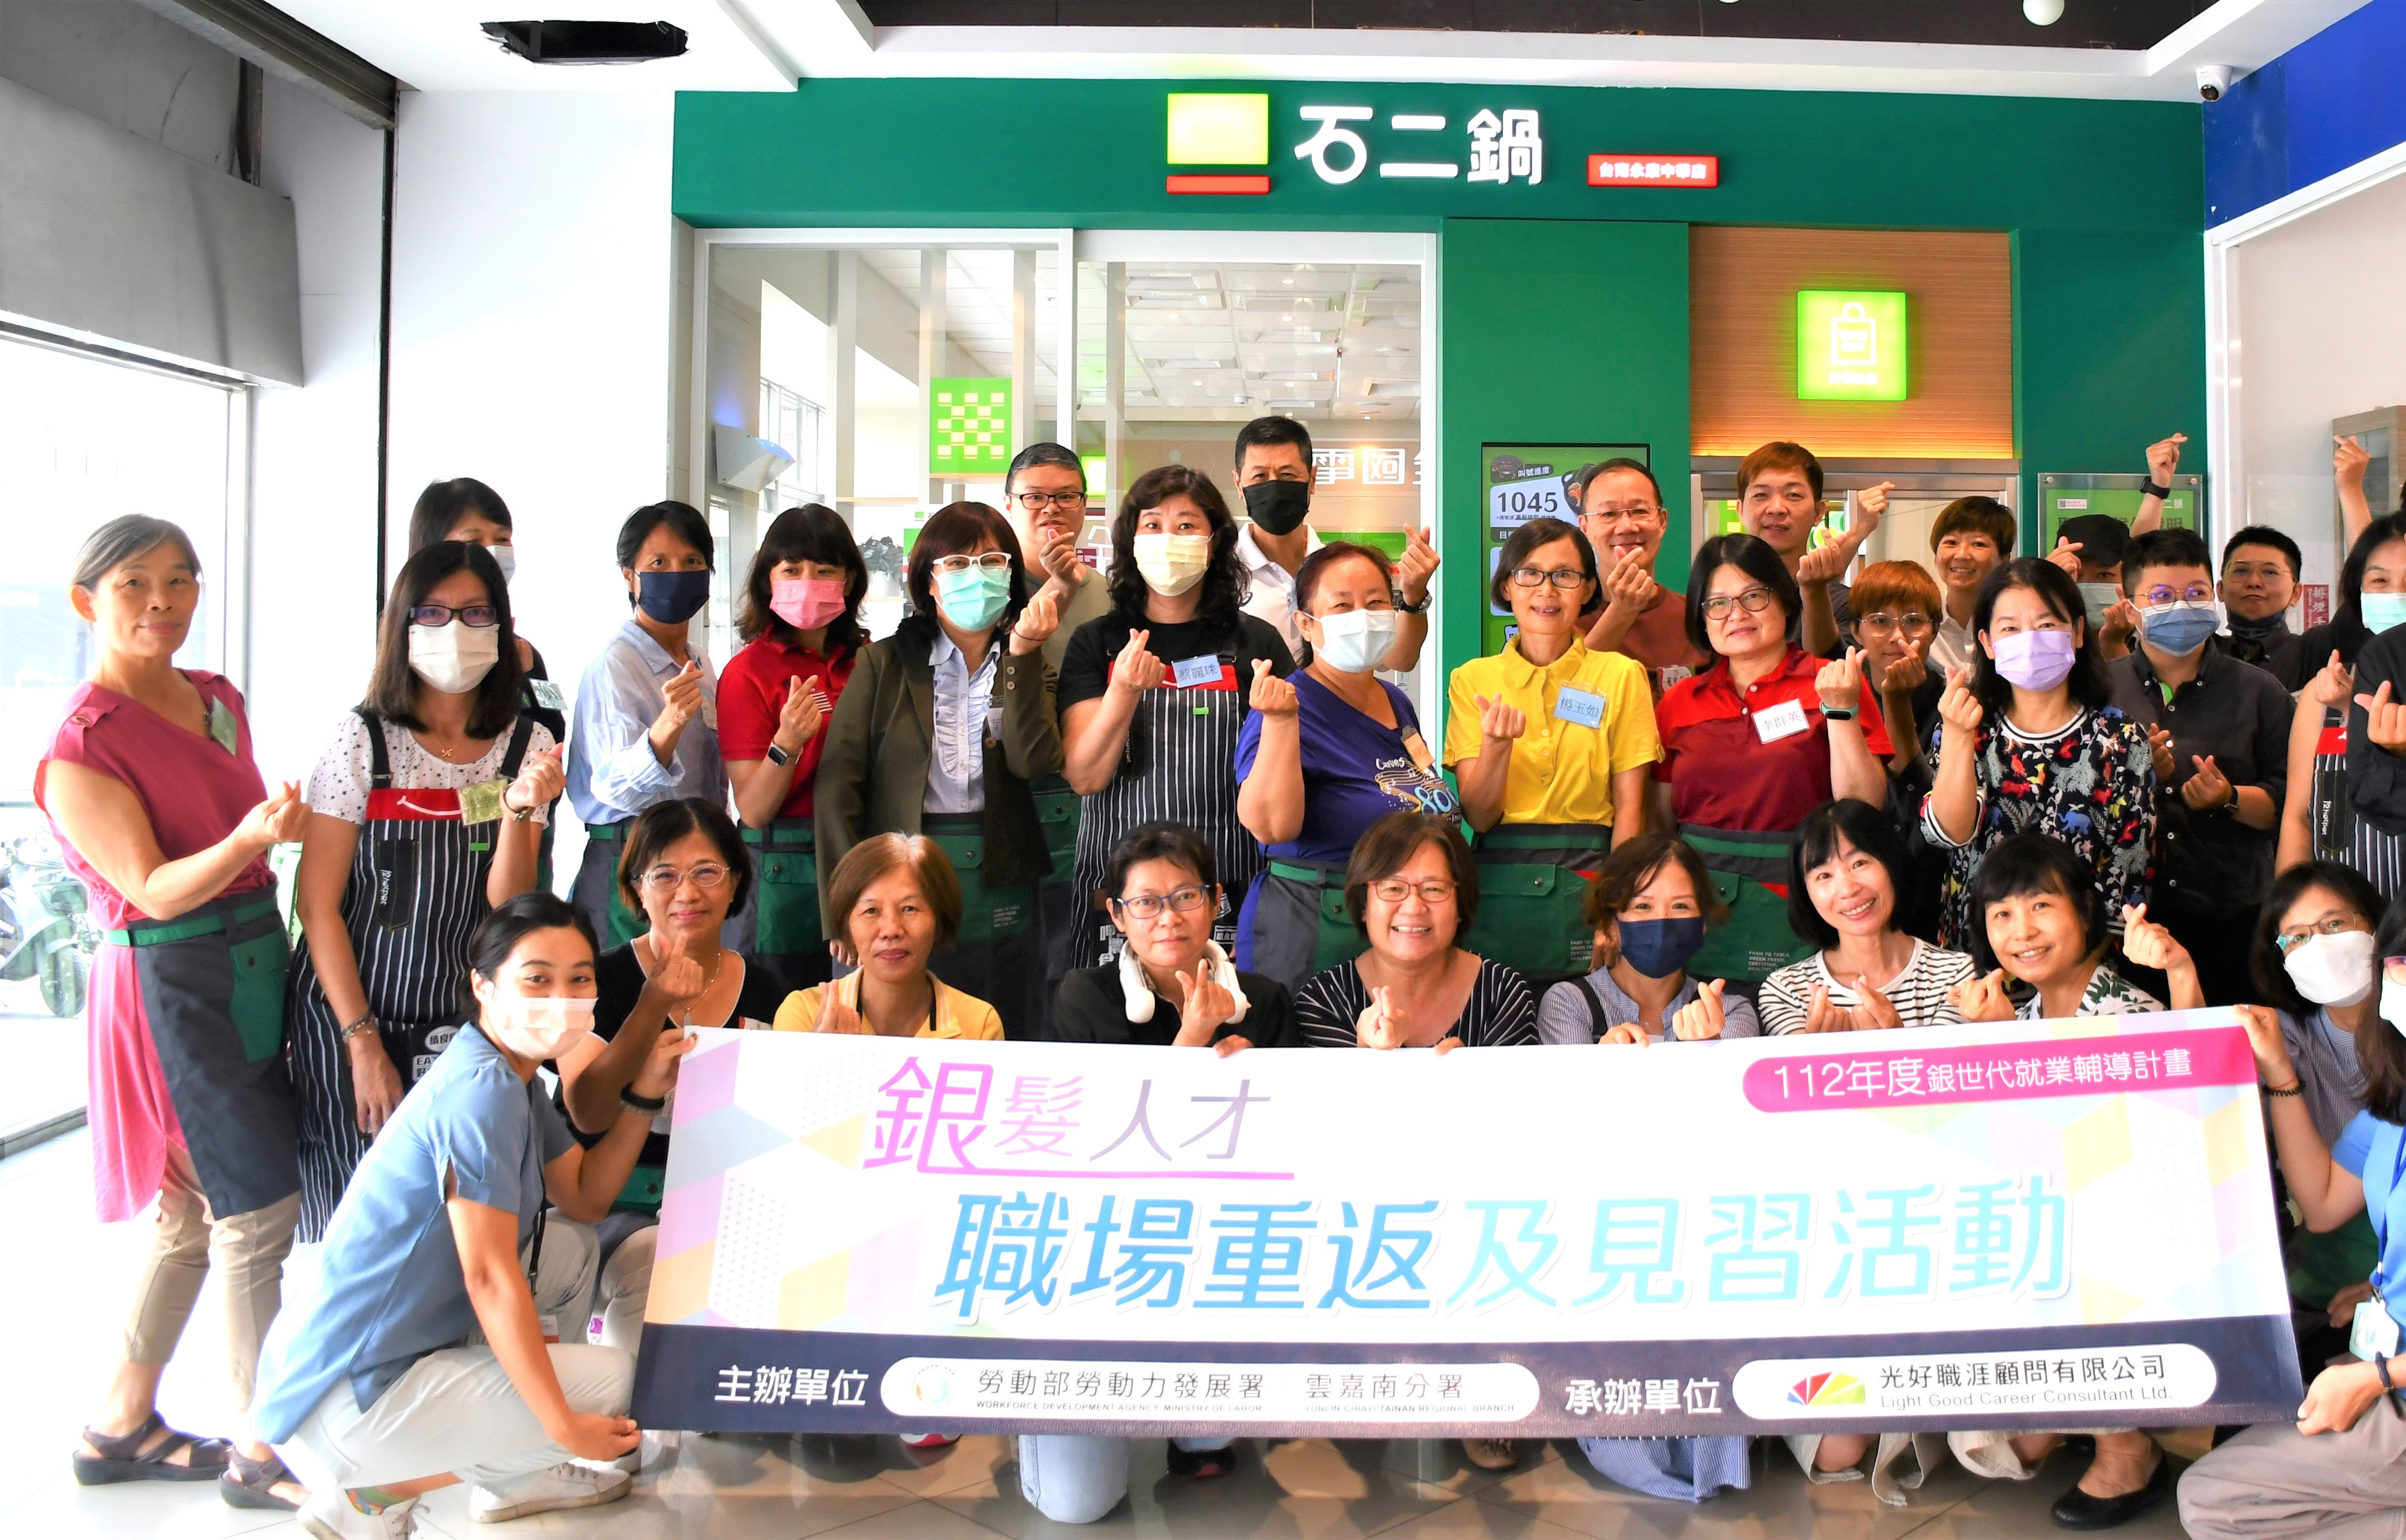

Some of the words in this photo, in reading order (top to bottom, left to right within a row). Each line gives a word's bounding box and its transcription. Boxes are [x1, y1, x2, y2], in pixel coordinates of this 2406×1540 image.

[1294, 105, 1543, 185] 石二鍋
[1599, 161, 1706, 179] 台南永康中華店
[1518, 466, 1550, 477] 叫號進度
[1497, 492, 1558, 513] 1045
[1560, 697, 1599, 718] 楊玉如
[1375, 756, 1405, 770] Curves
[1774, 1048, 2192, 1099] 112年度銀世代就業輔導計畫
[862, 1055, 1272, 1173] 銀髮人才
[931, 1175, 2067, 1319] 職場重返及見習活動
[714, 1364, 869, 1406] 主辦單位
[978, 1368, 1264, 1399] 勞動部勞動力發展署
[1306, 1373, 1463, 1399] 雲嘉南分署
[1880, 1354, 2165, 1389] 光好職涯顧問有限公司
[977, 1400, 1039, 1410] WORKFORCE
[1043, 1402, 1114, 1411] DEVELOPMENT
[1472, 1404, 1515, 1412] BRANCH
[1565, 1377, 1721, 1415] 承辦單位
[1881, 1395, 1922, 1410] Light
[1929, 1393, 1973, 1407] Good
[1980, 1392, 2037, 1405] Career
[2044, 1388, 2135, 1403] Consultant
[2141, 1386, 2173, 1400] Ltd.
